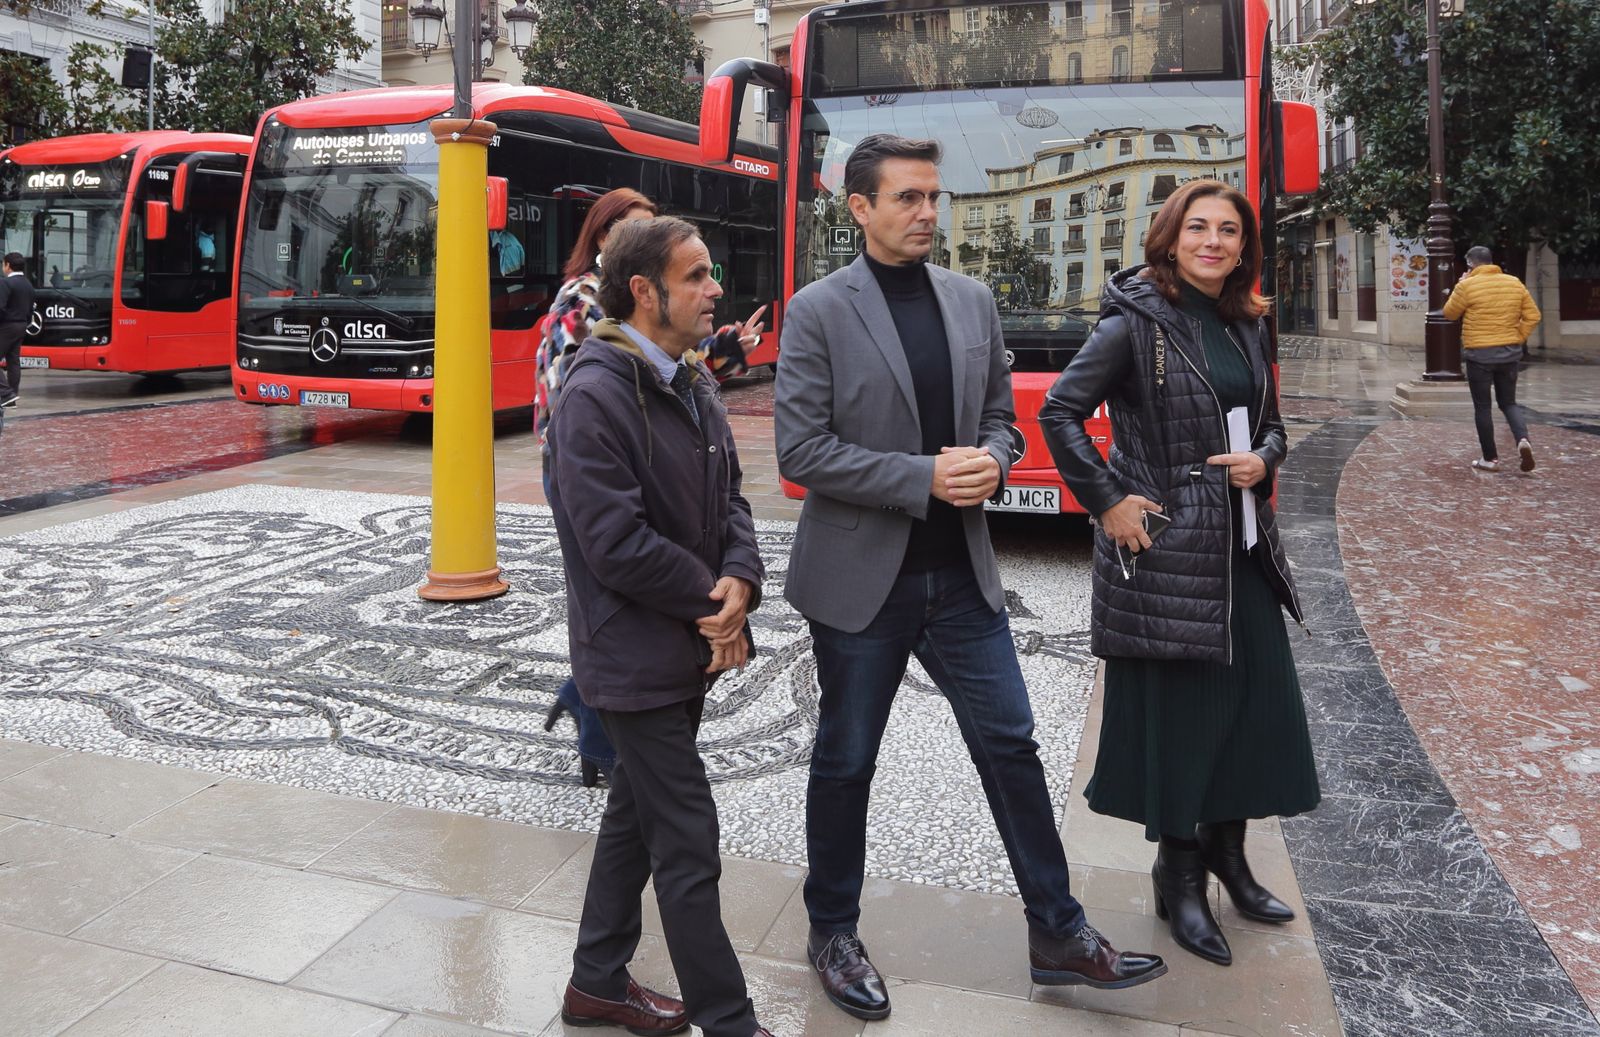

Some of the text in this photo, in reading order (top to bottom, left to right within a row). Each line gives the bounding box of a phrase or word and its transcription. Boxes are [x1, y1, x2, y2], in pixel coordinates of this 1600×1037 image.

[293, 132, 427, 150] Autobuses Urbanos
[335, 146, 403, 164] Granada
[148, 169, 169, 180] 11696
[734, 159, 770, 175] CITARO
[28, 171, 66, 188] alsa
[46, 304, 75, 318] alsa
[344, 320, 386, 338] alsa
[1155, 347, 1165, 375] DANCE
[307, 393, 347, 405] 4728 MCR
[1019, 489, 1054, 508] MCR
